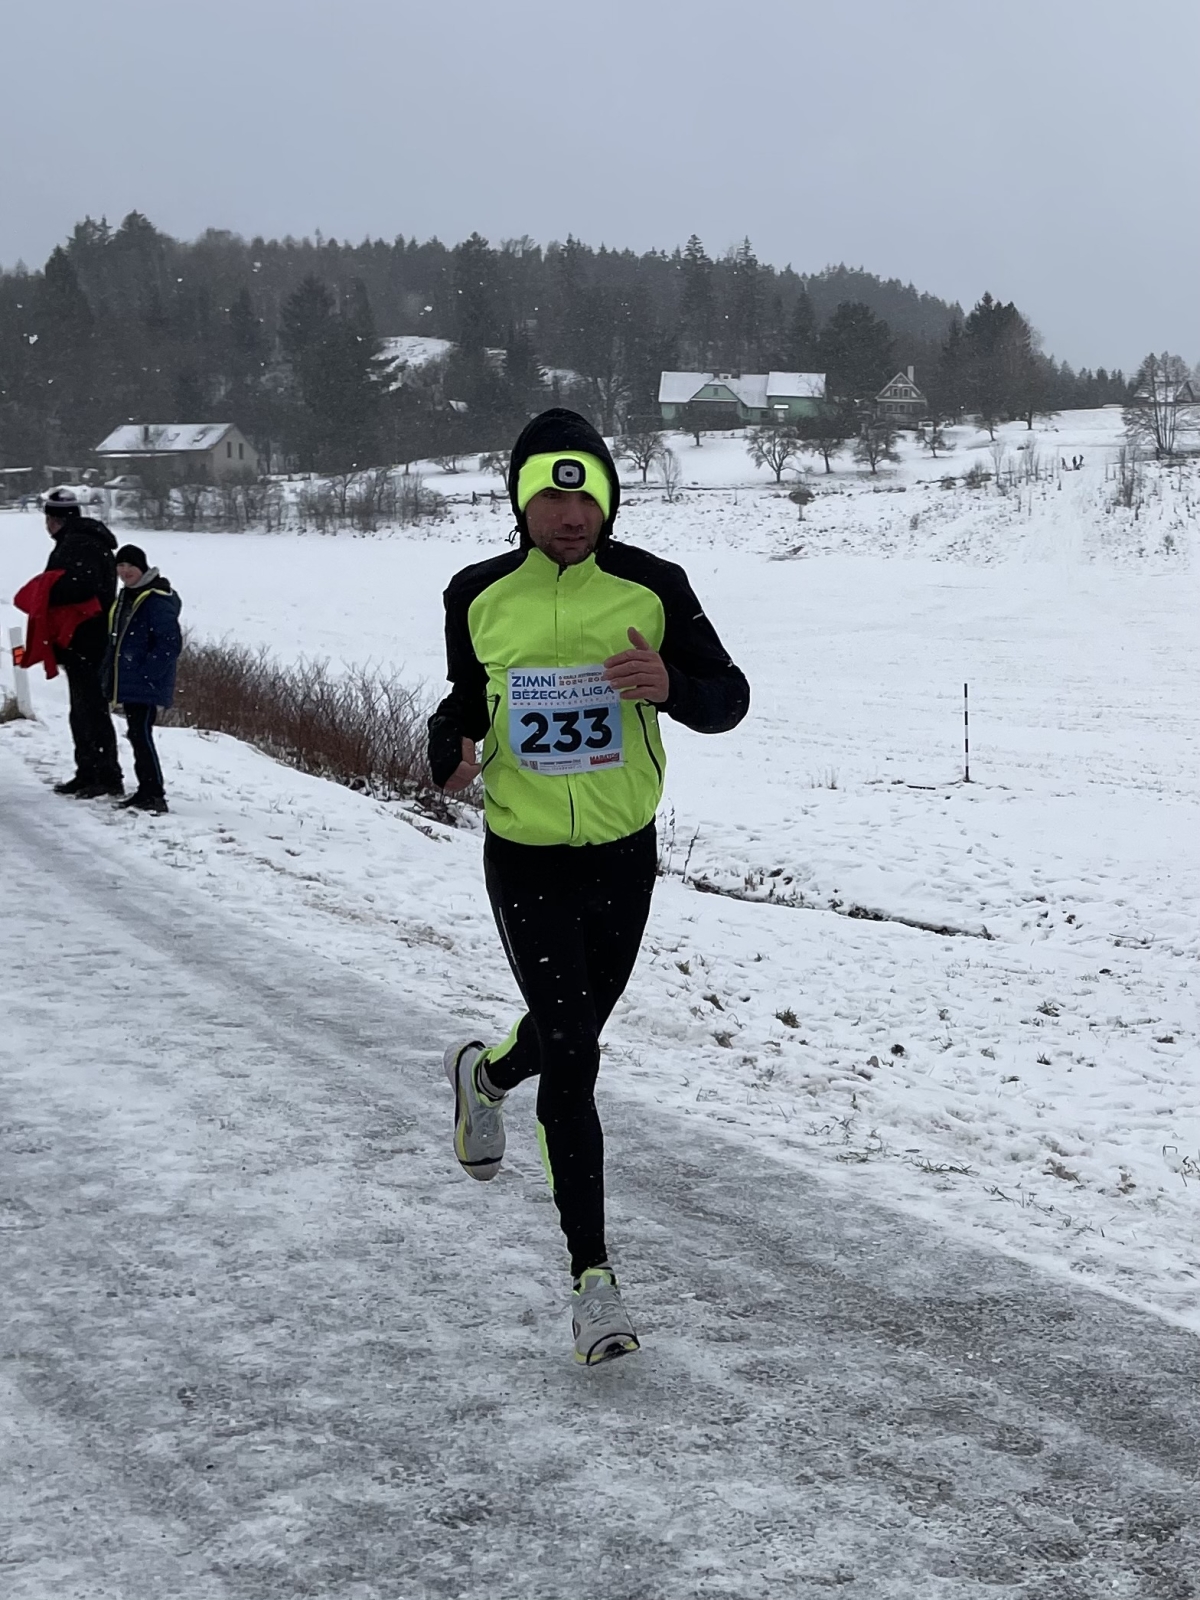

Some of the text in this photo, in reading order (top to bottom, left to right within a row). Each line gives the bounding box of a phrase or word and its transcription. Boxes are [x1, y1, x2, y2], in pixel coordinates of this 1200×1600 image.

[512, 674, 556, 687] ZIMNÍ
[559, 676, 606, 686] 2024-202
[512, 686, 614, 700] BĚŽECKÁ LIGA
[520, 707, 613, 753] 233
